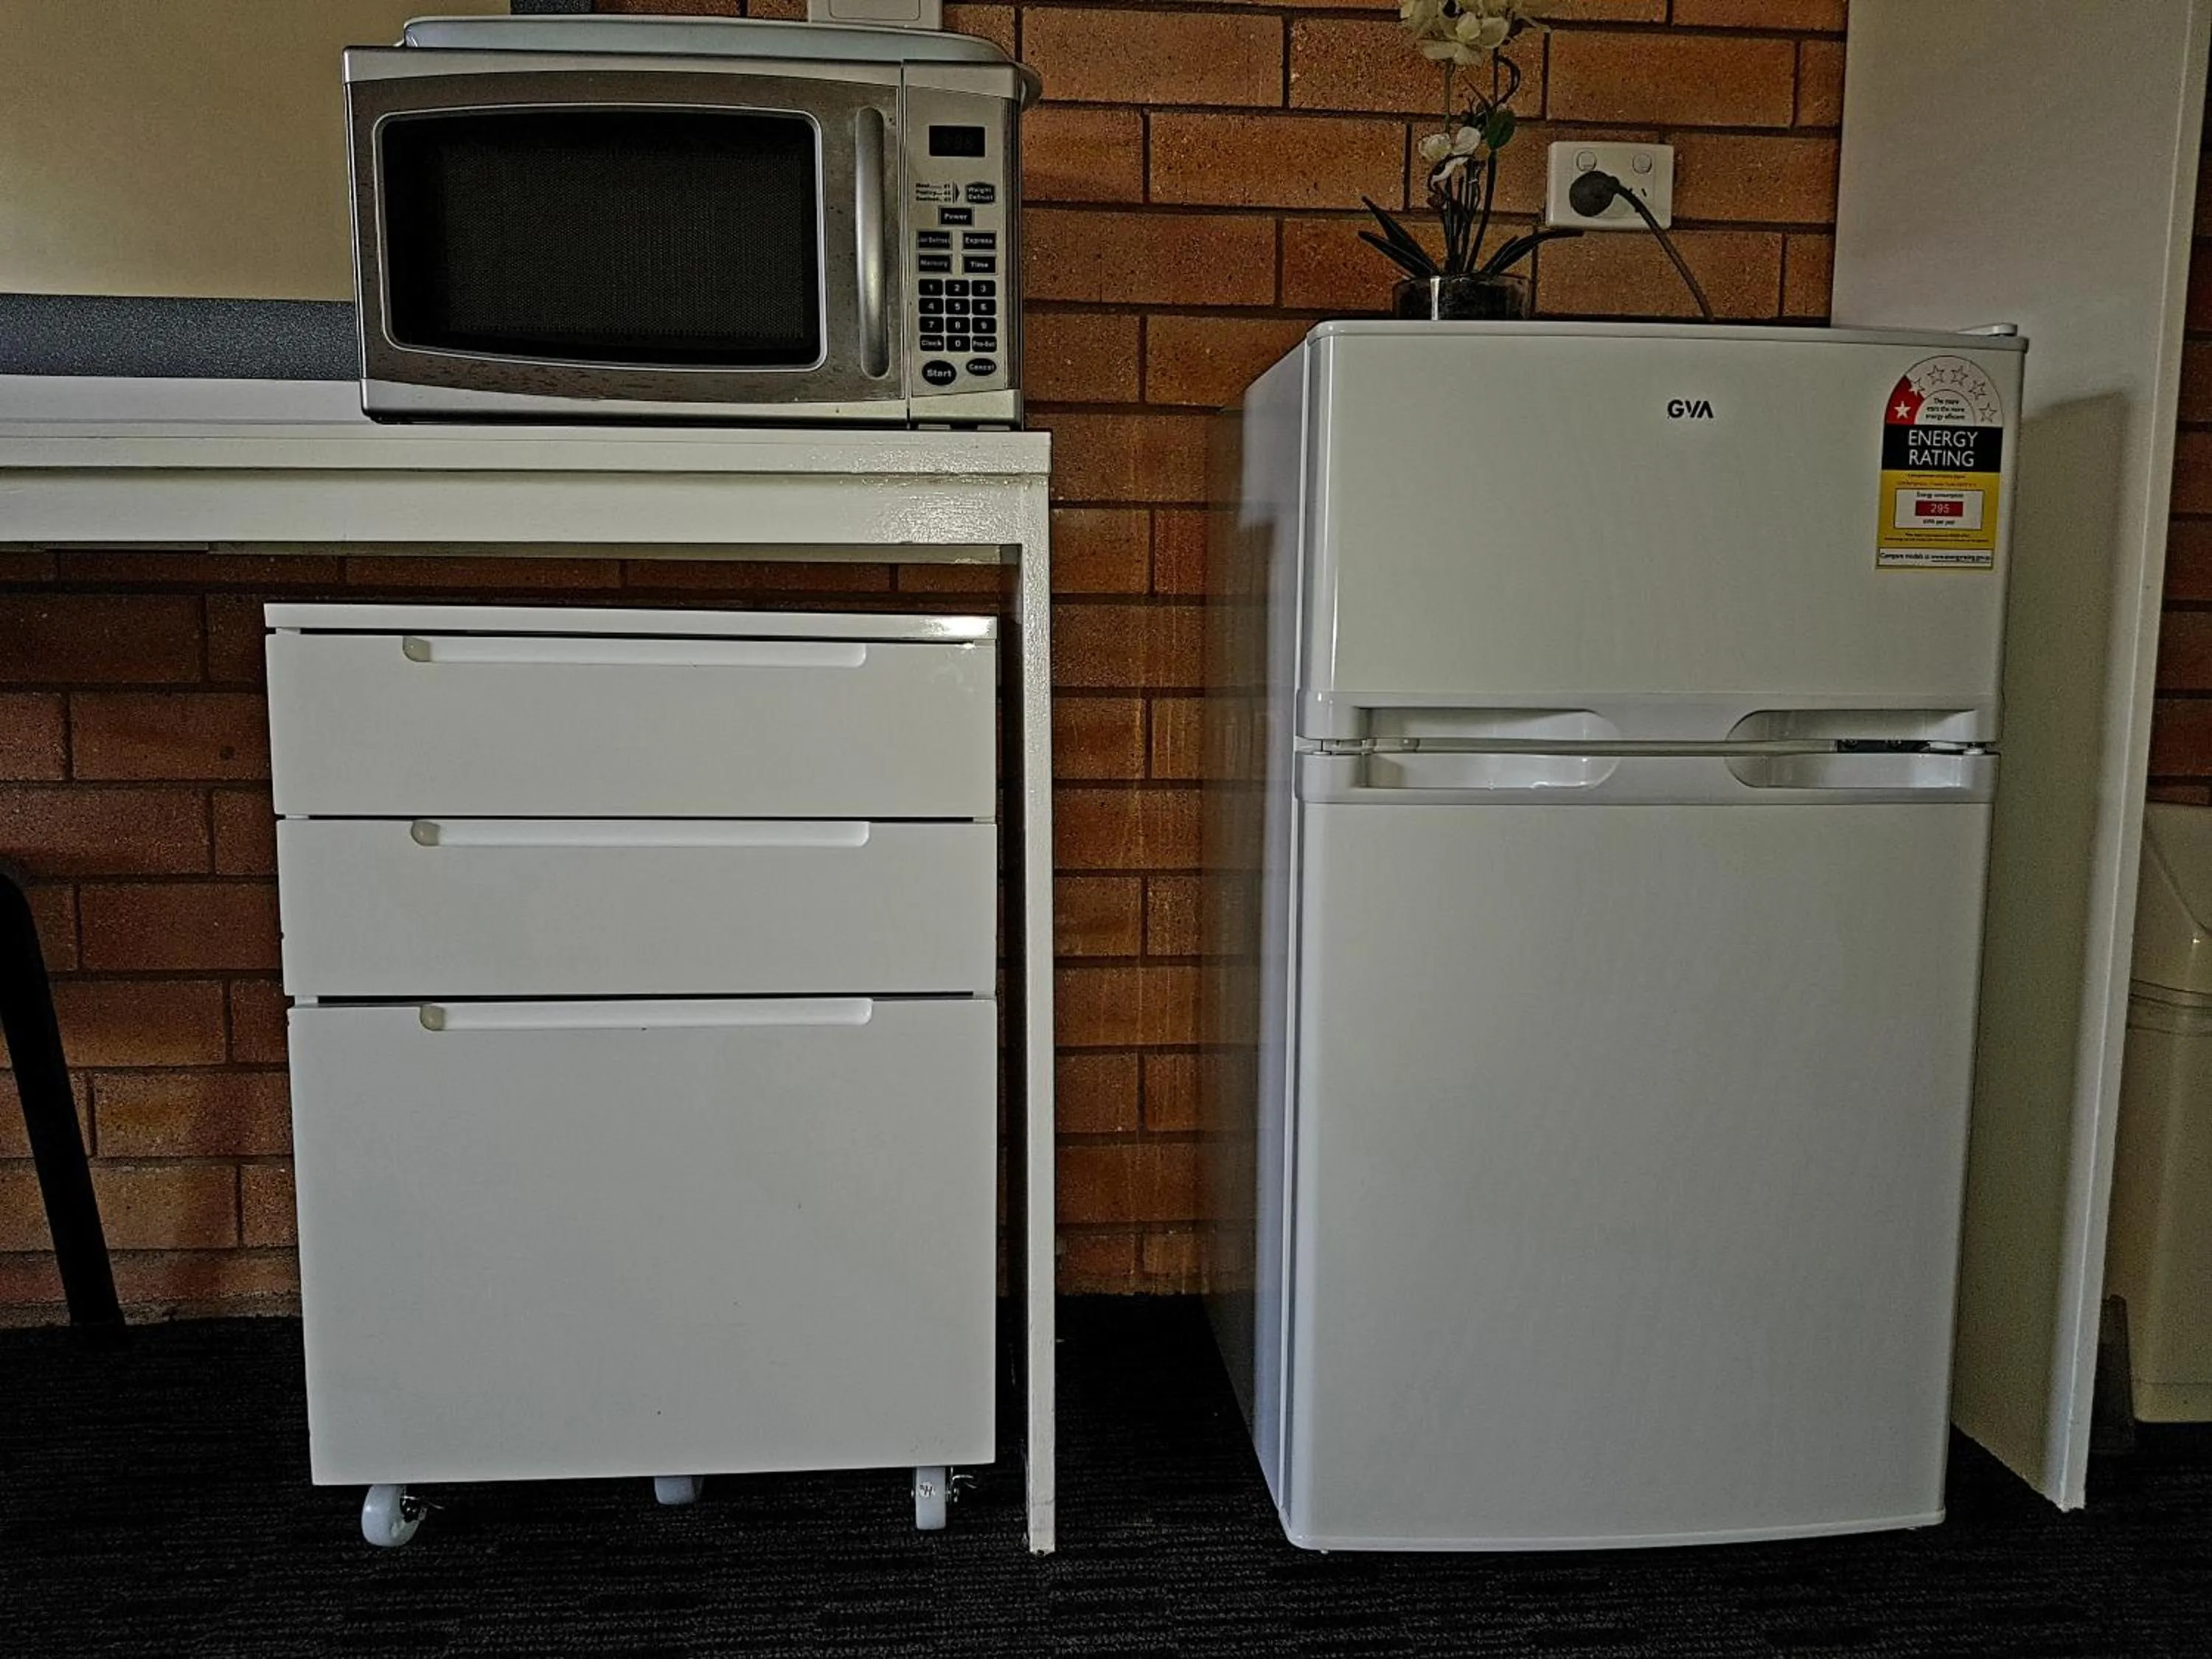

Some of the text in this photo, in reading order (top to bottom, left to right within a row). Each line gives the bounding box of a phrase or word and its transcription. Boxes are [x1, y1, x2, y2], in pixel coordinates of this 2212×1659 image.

[954, 284, 960, 292] 2
[980, 284, 987, 293] 3
[928, 302, 934, 310] 4
[955, 302, 960, 310] 5
[980, 303, 987, 311] 6
[955, 321, 960, 330] 8
[927, 369, 952, 378] Start
[1668, 399, 1714, 419] GVA
[1908, 430, 1978, 448] ENERGY
[1908, 449, 1975, 467] RATING
[1930, 504, 1950, 514] 295
